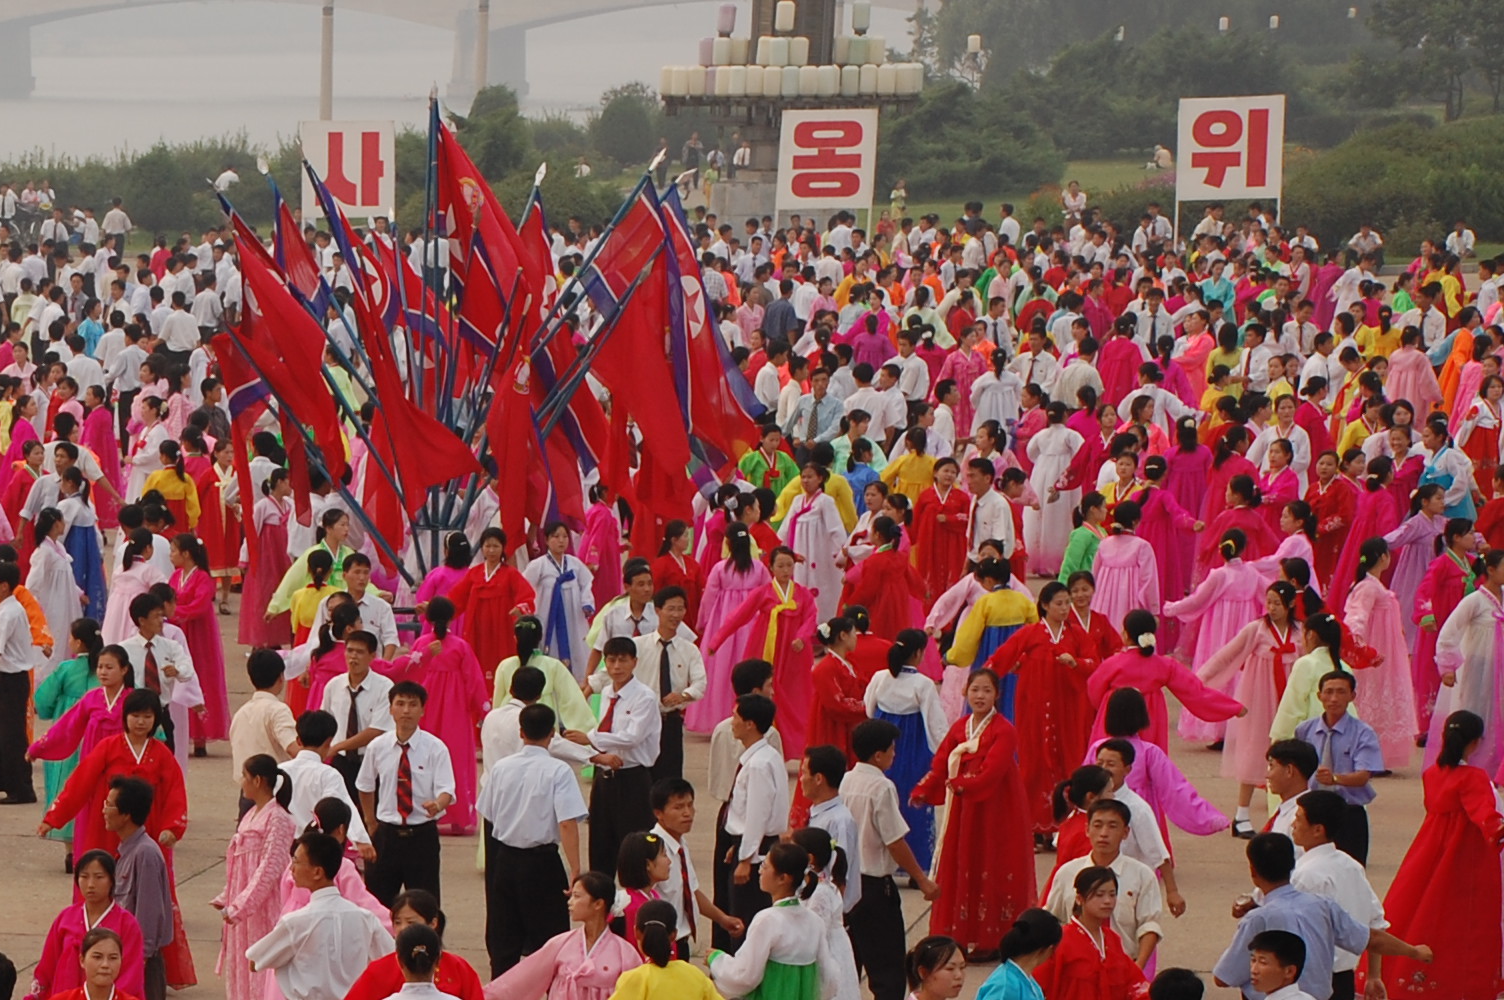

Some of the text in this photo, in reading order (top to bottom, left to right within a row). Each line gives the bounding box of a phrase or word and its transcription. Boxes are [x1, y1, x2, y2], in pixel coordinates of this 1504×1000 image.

[315, 131, 384, 207] 사
[791, 120, 863, 198] 옹
[1191, 108, 1269, 189] 위
